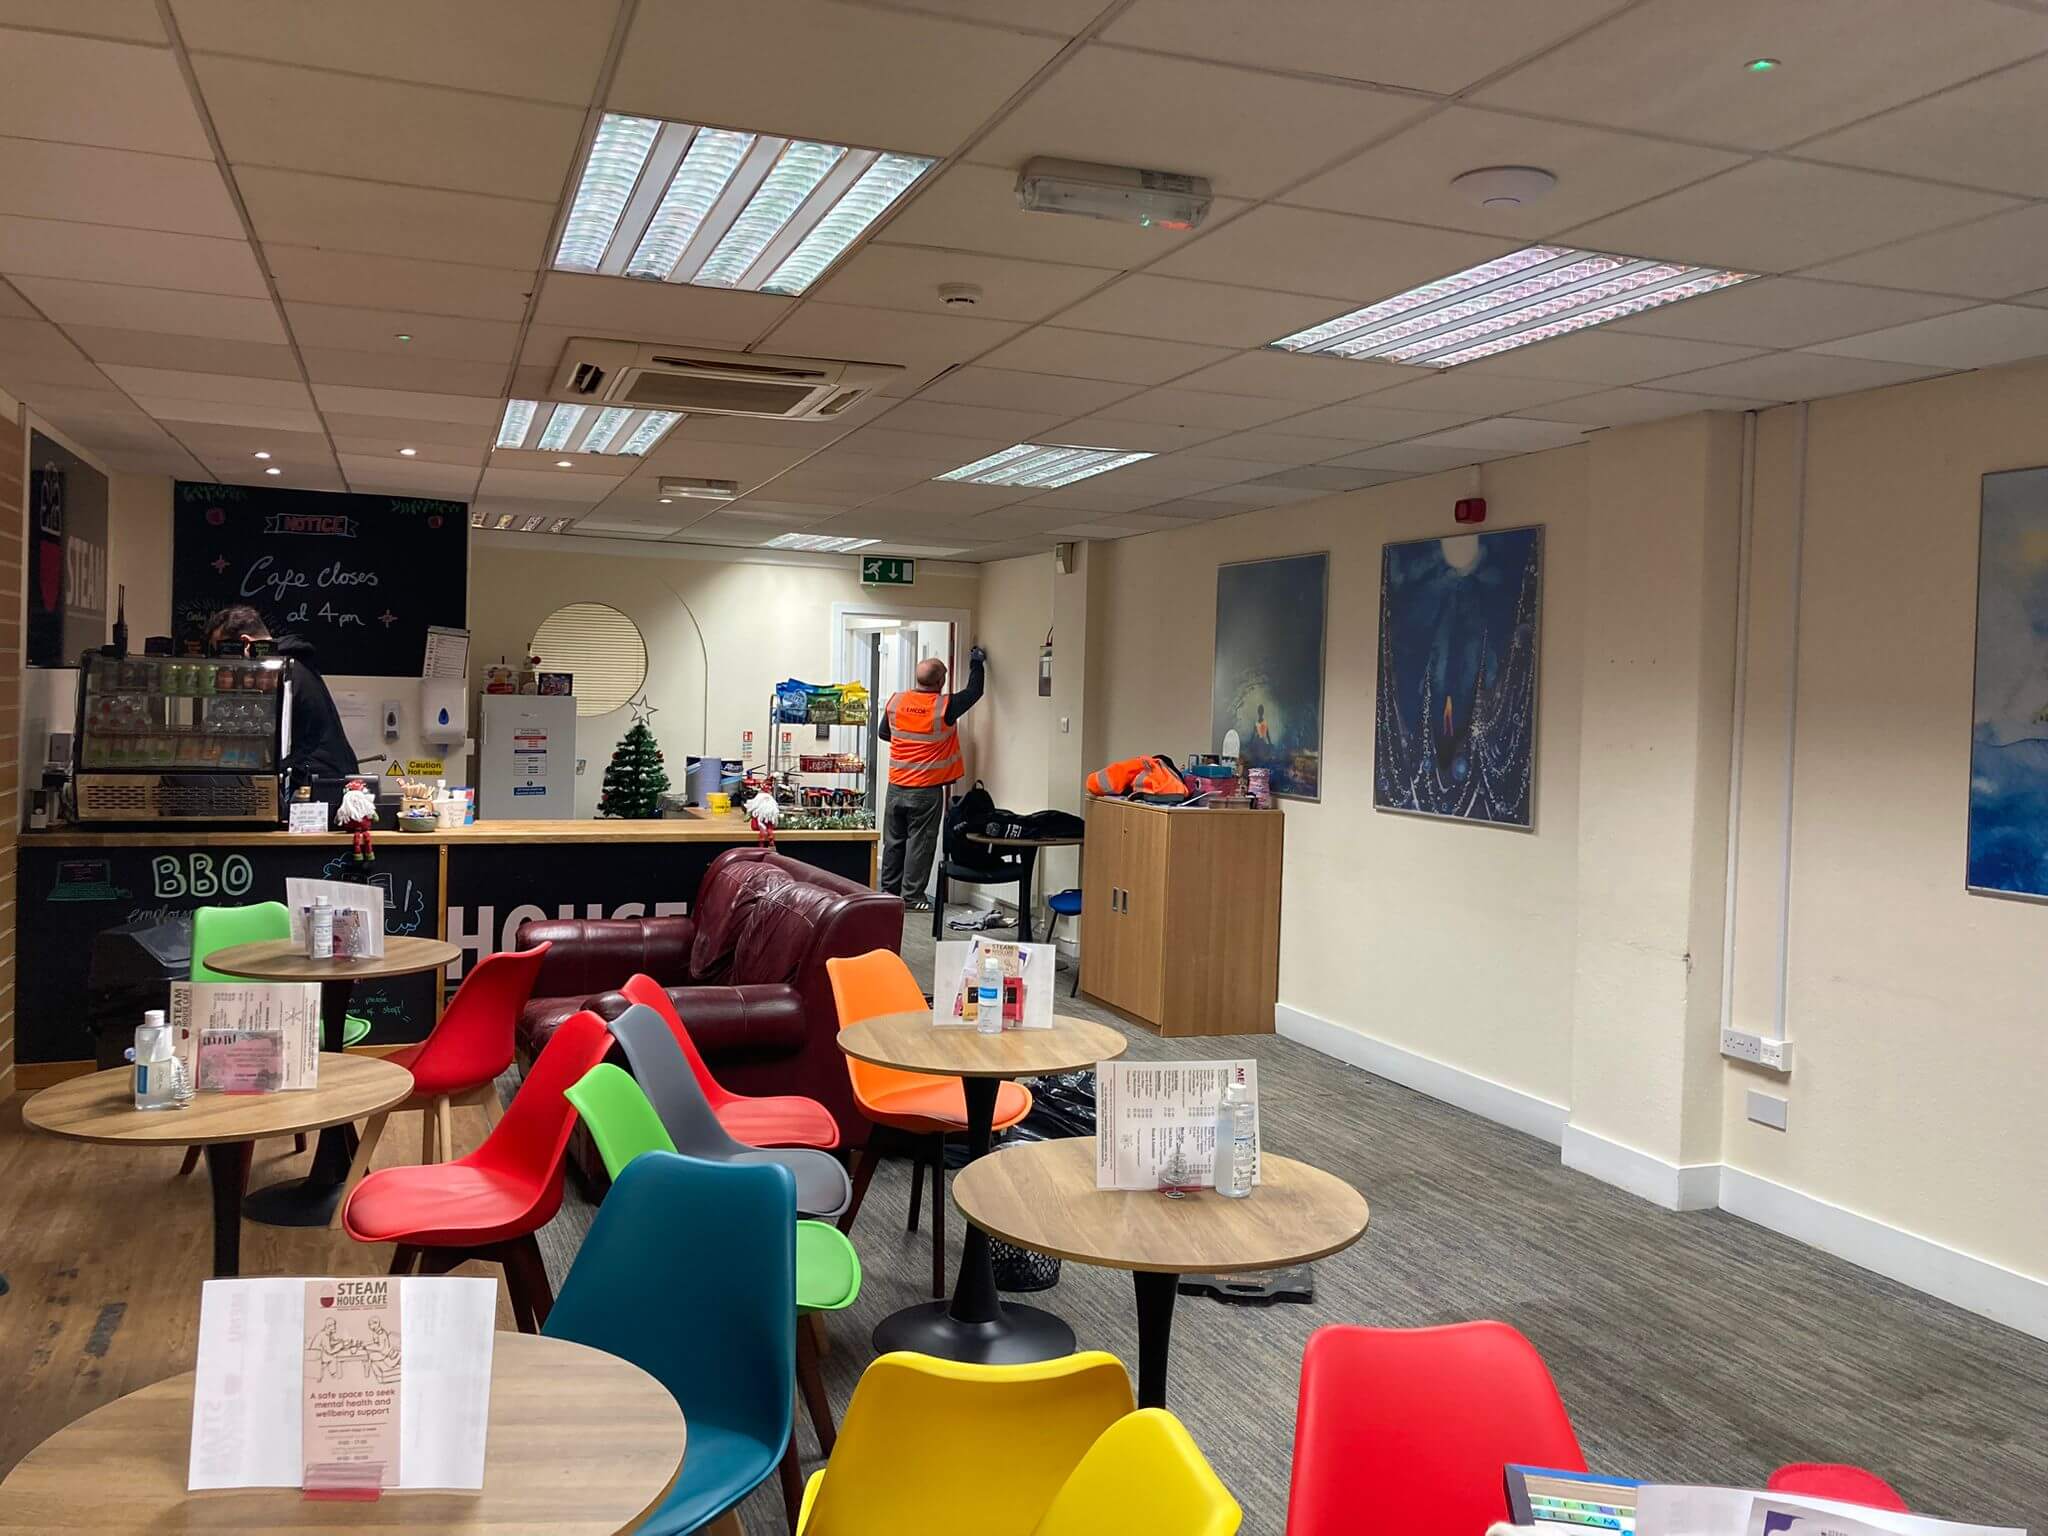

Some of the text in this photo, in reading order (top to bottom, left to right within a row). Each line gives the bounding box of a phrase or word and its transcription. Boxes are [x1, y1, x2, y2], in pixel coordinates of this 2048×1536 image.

[285, 516, 344, 533] NOTICE
[240, 556, 379, 600] Cafe closes
[152, 853, 253, 898] BBO
[174, 988, 183, 1026] STEAM
[337, 1281, 388, 1296] STEAM
[336, 1294, 388, 1306] HOUSE CAFE
[310, 1392, 316, 1400] A
[318, 1391, 336, 1399] safe
[338, 1391, 363, 1399] space
[376, 1388, 396, 1397] seek
[346, 1399, 373, 1407] health
[375, 1398, 391, 1406] and
[316, 1407, 390, 1418] wellbeing support
